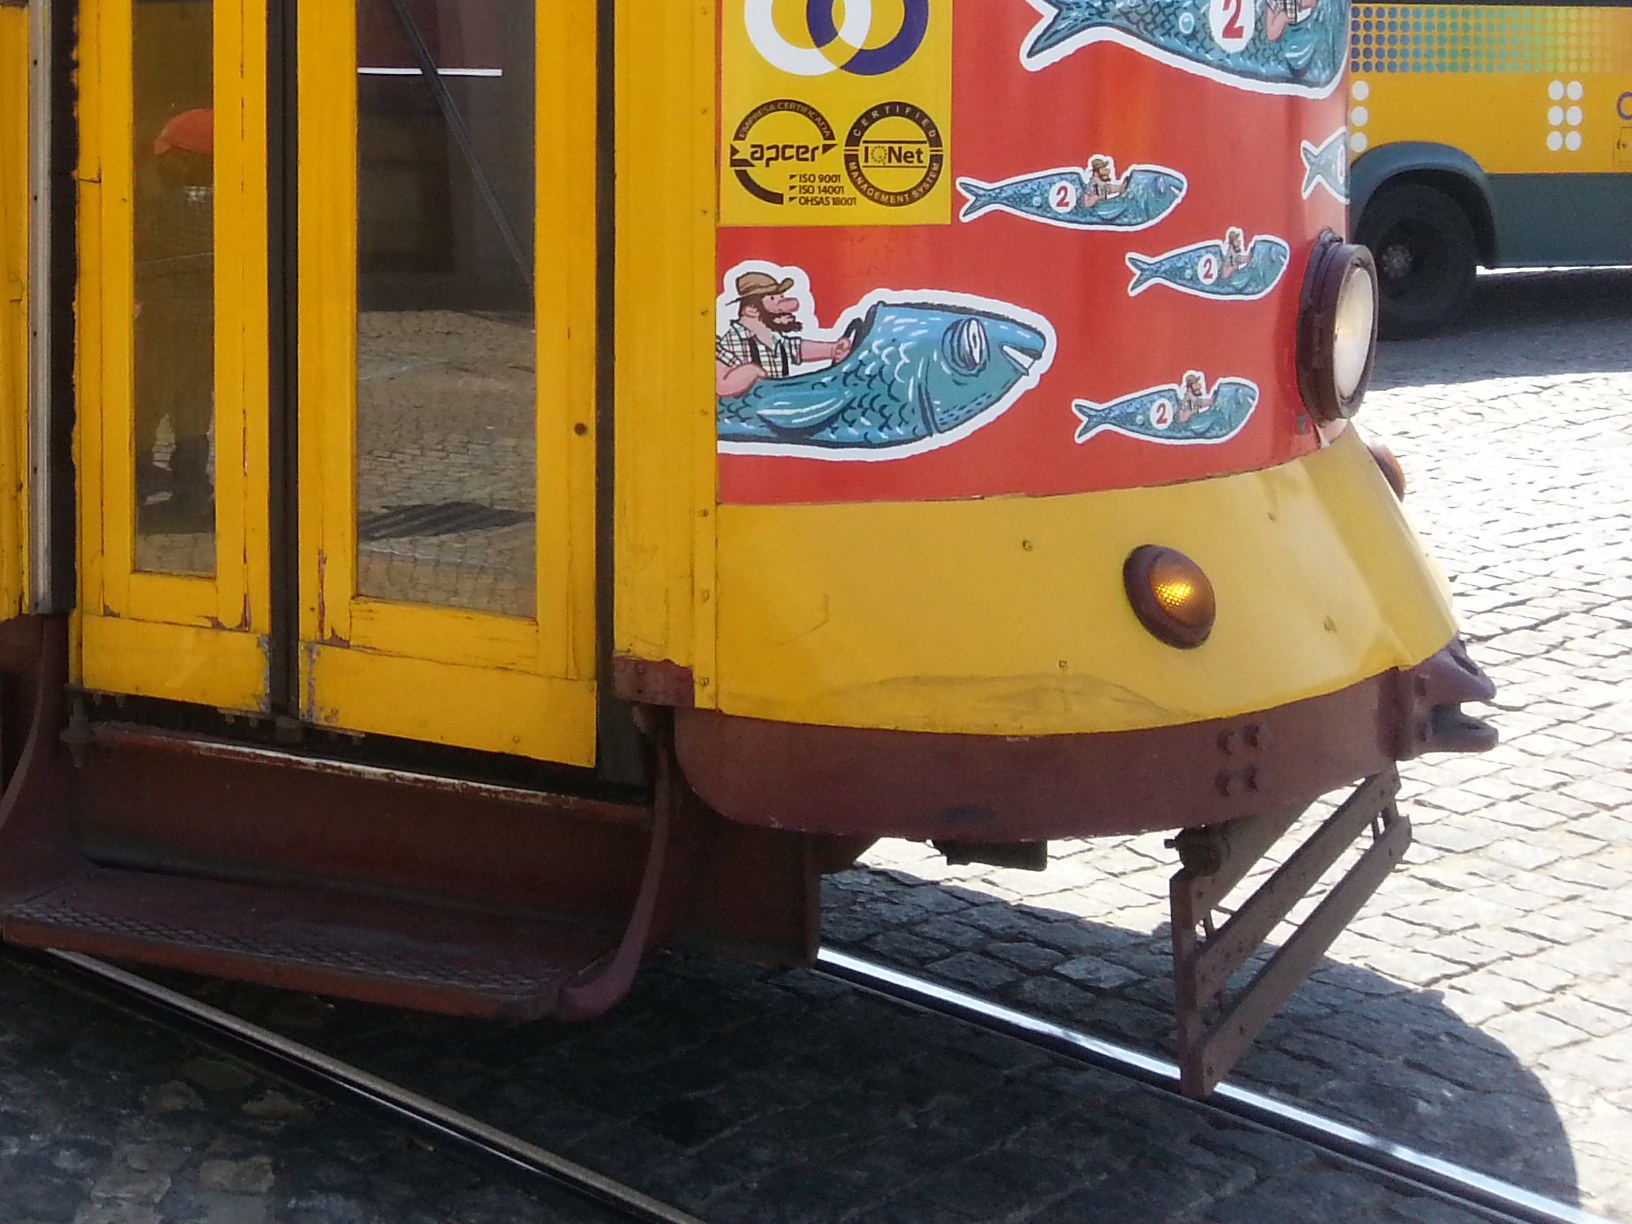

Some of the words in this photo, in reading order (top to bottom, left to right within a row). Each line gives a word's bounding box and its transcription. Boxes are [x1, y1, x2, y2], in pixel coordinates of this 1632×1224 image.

[737, 103, 776, 138] EMPRESA
[776, 101, 831, 138] CERTIFICADA
[852, 105, 937, 137] CERTIFIED
[750, 144, 820, 168] apcer
[863, 145, 925, 166] IQNet
[798, 173, 816, 183] ISO
[817, 174, 841, 183] 9001
[848, 161, 910, 205] MANAGEMENT
[911, 161, 941, 199] SYSTEM
[798, 185, 815, 194] ISO
[817, 185, 845, 195] 14001
[798, 196, 831, 206] OHSAS
[831, 197, 857, 206] 18001
[1055, 185, 1070, 208] 2
[1203, 258, 1214, 280] 2
[1156, 402, 1168, 425] 2
